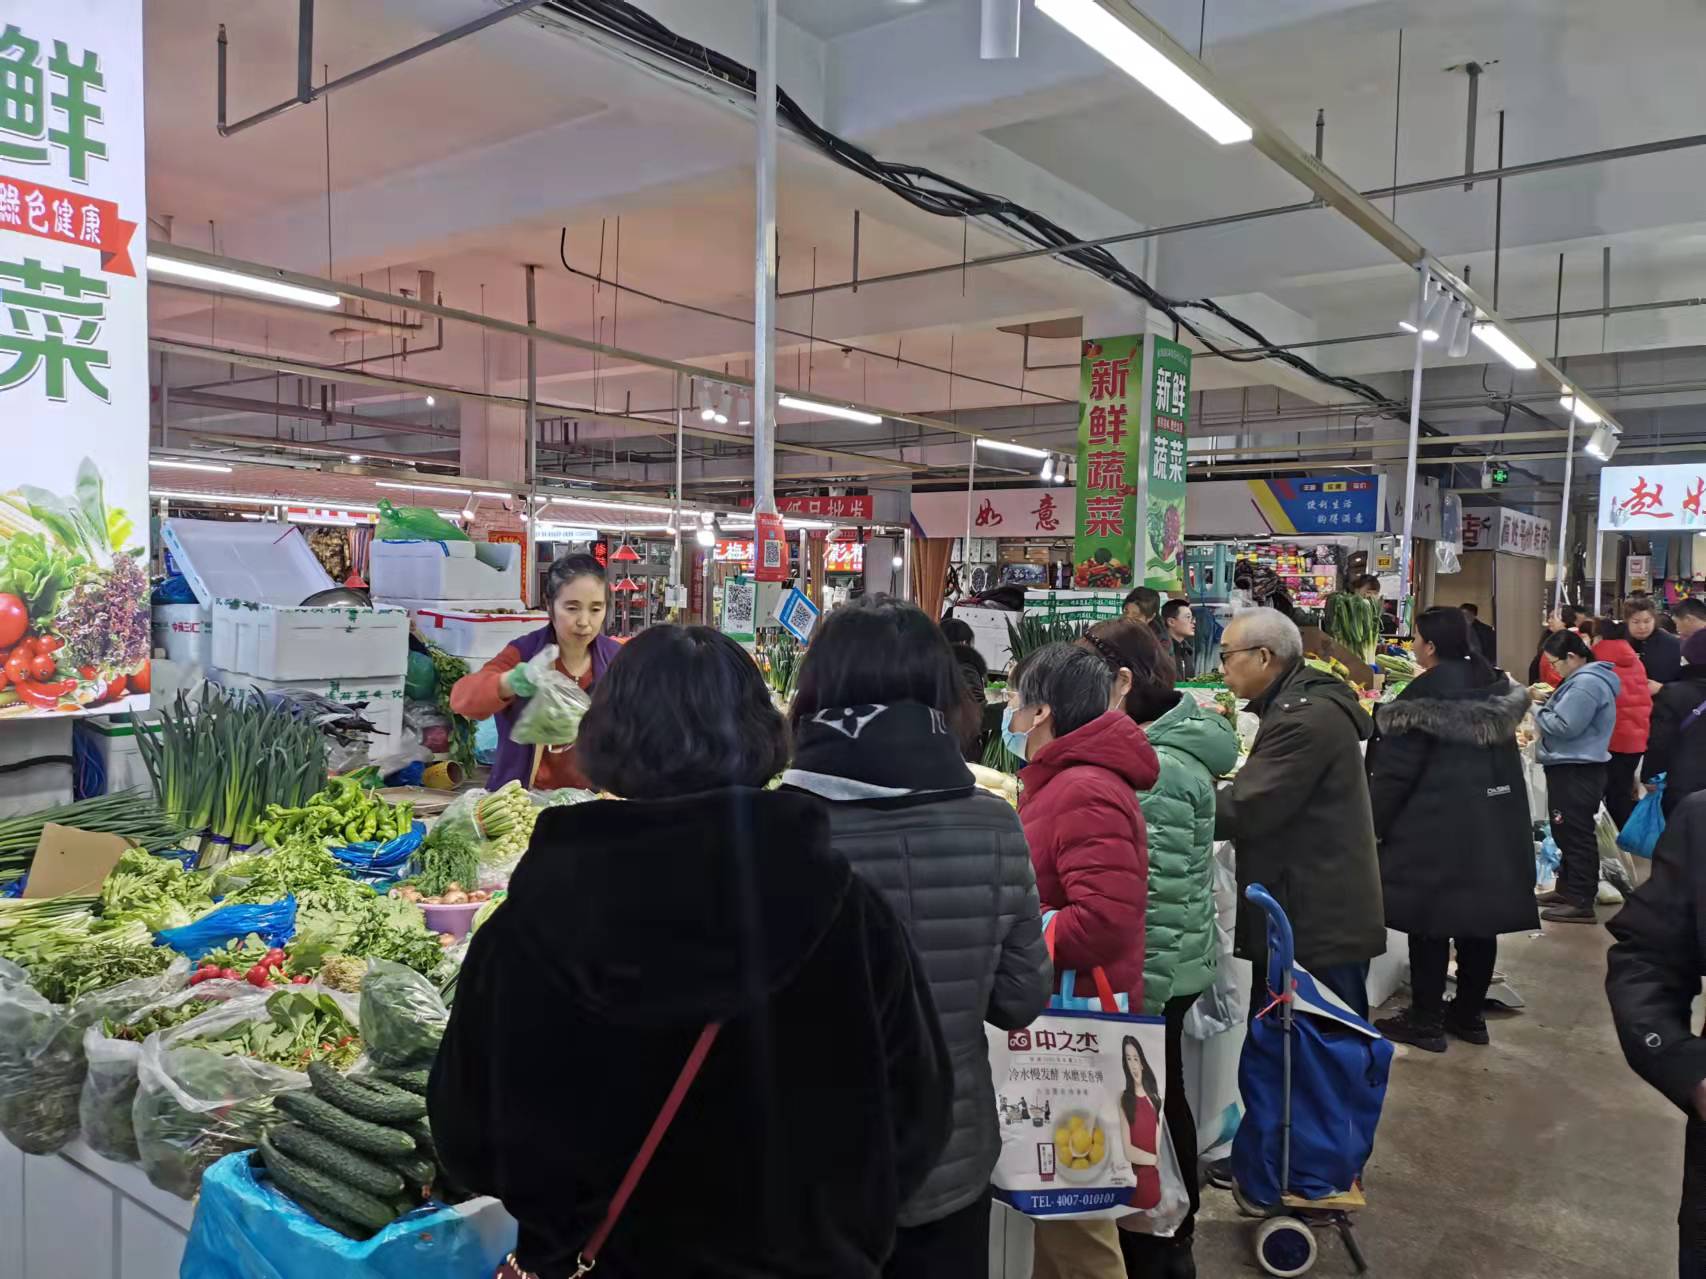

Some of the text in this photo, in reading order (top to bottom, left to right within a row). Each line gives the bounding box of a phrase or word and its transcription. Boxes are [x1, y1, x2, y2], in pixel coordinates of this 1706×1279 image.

[1155, 367, 1186, 417] 新鲜
[1084, 357, 1131, 538] 新鲜蔬菜
[1153, 435, 1184, 483] 蔬菜
[975, 493, 1060, 533] 如意
[1035, 1029, 1099, 1053] 中之杰
